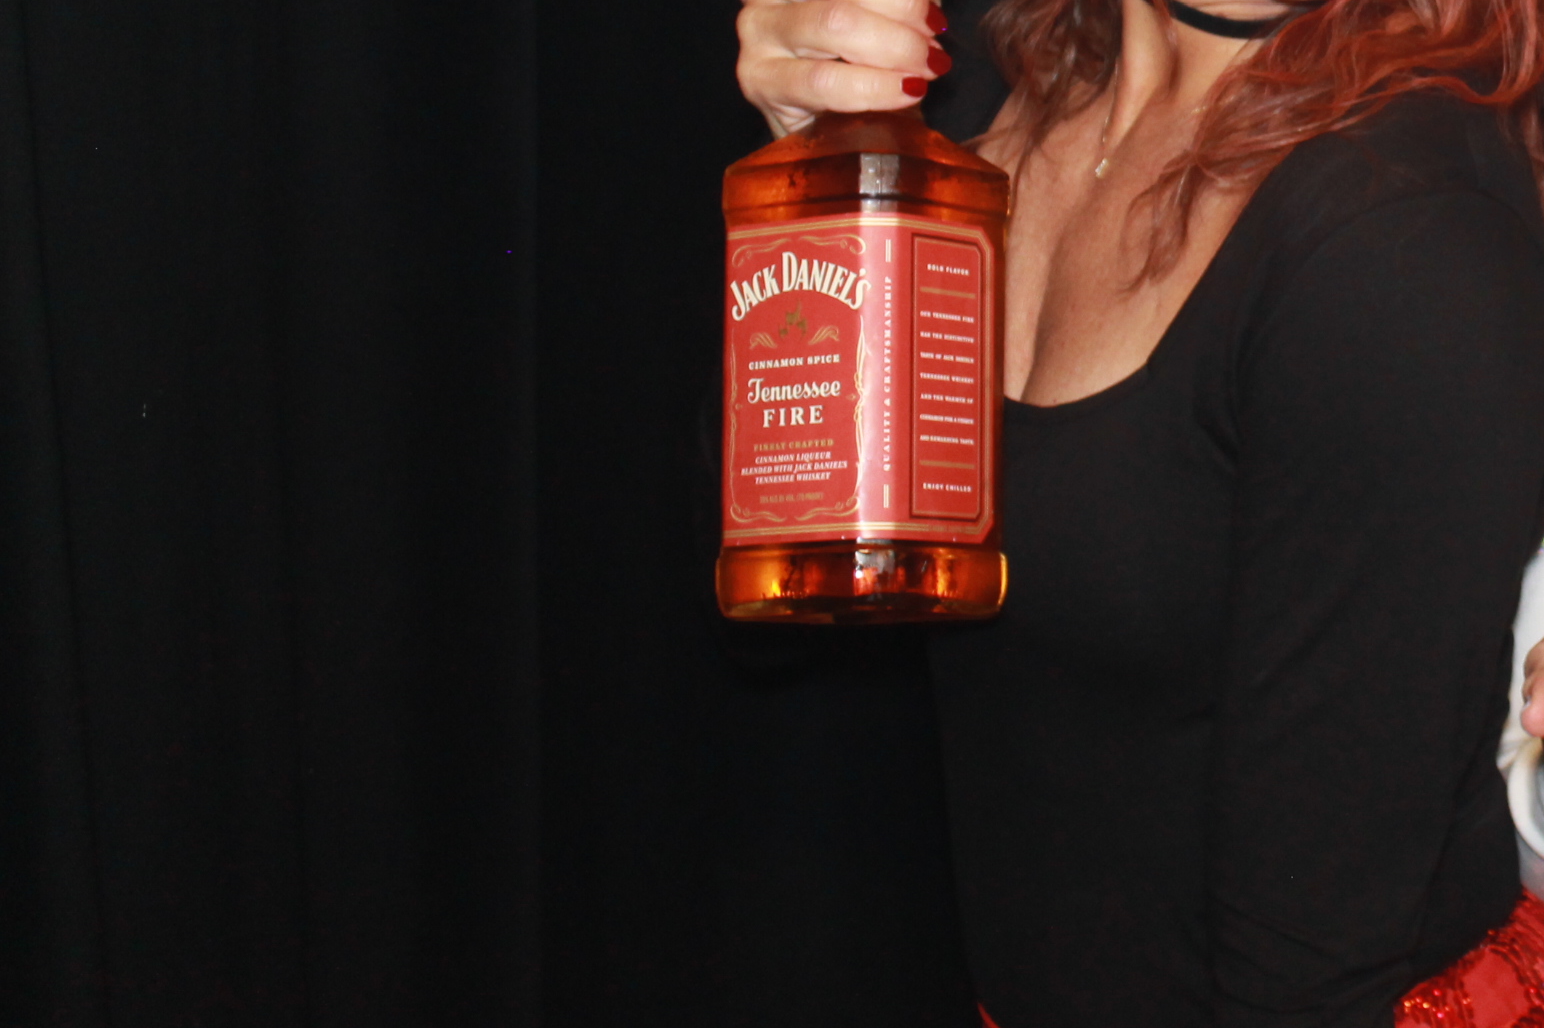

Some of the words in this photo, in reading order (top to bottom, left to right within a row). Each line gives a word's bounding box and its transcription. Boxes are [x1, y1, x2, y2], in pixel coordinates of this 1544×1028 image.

[927, 263, 944, 272] BOLD
[945, 266, 970, 276] FLAVOR
[730, 264, 780, 321] JACK
[782, 251, 872, 310] DANIEL'S
[883, 276, 892, 393] CRAFTSMANSHIP
[748, 357, 804, 370] CINNAMON
[807, 354, 840, 365] SPICE
[747, 377, 841, 404] Tennessee
[762, 404, 824, 428] FIRE
[753, 442, 786, 452] FINELY
[788, 438, 834, 449] CRAFTED
[883, 411, 891, 472] QUALITY
[755, 453, 795, 464] CINNAMON
[795, 451, 832, 463] LIQUEUR
[741, 465, 773, 476] BLENDED
[773, 464, 793, 473] WITH
[793, 462, 813, 474] JACK
[755, 474, 795, 484] TENNESSEE
[796, 472, 832, 482] WHISKEY
[923, 482, 944, 490] ENJOY
[945, 484, 972, 493] CHILLED
